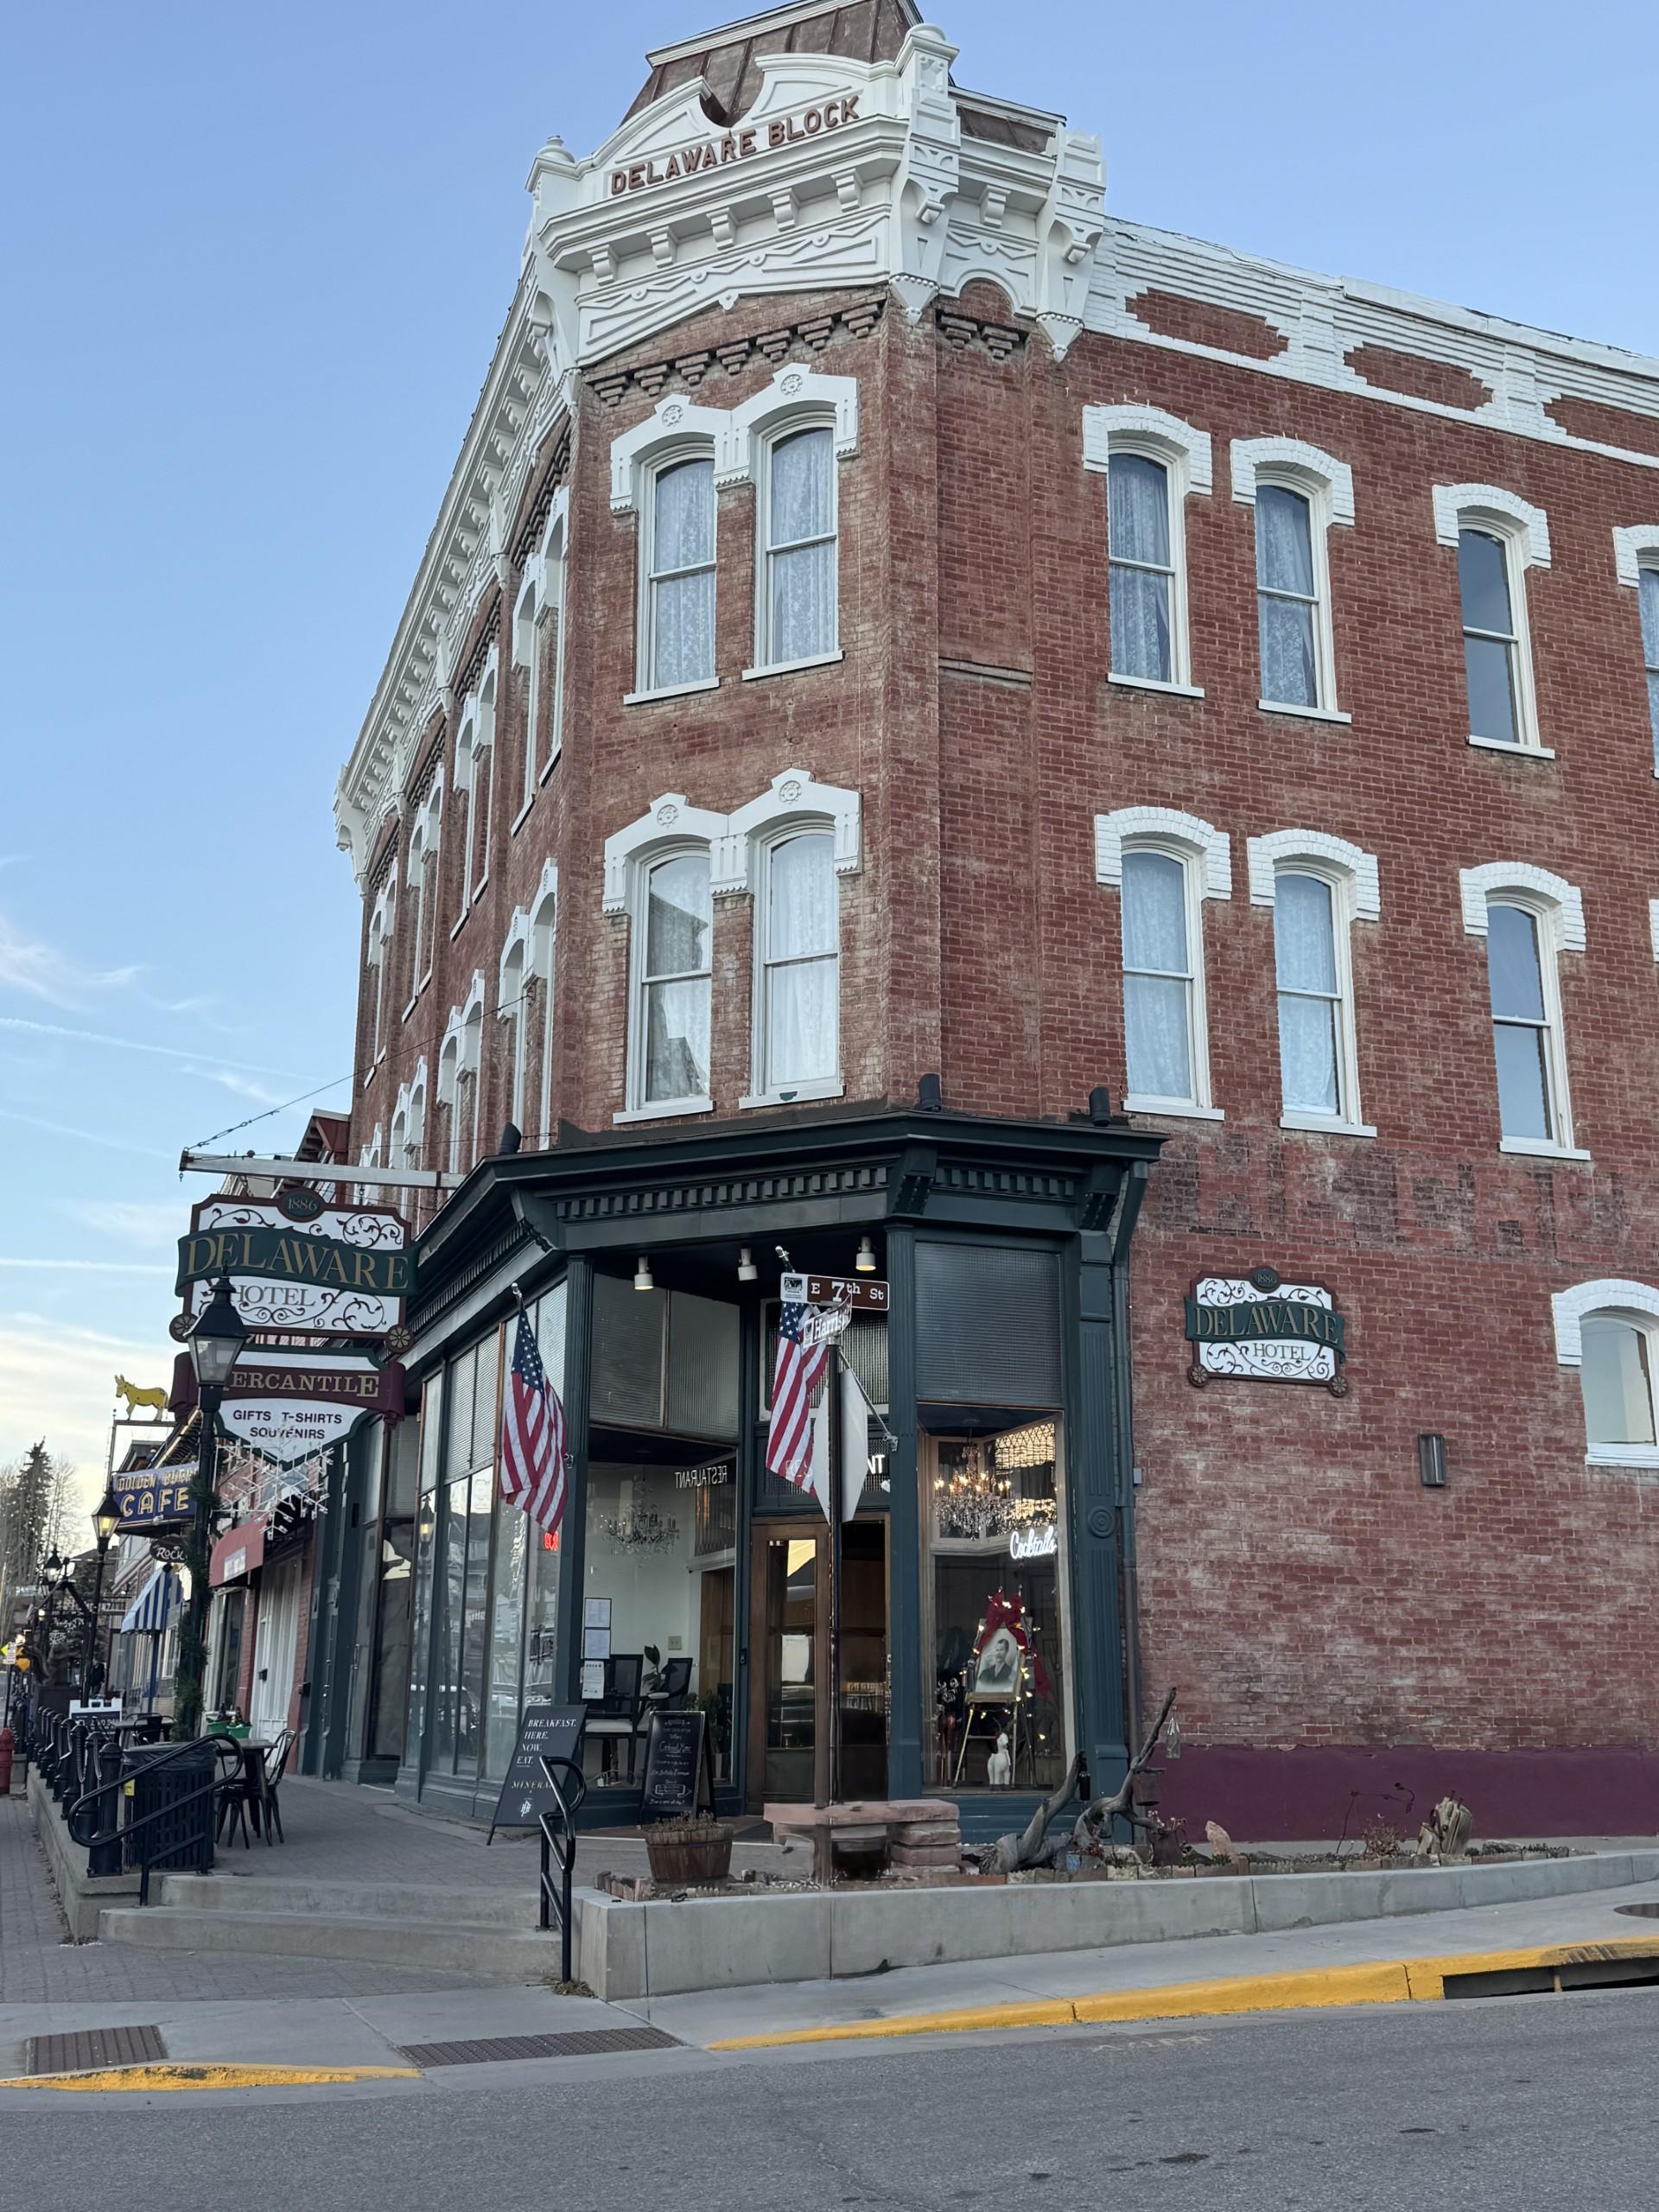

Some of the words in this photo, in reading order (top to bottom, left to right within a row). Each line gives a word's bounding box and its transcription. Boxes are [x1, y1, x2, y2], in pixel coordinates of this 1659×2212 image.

[610, 128, 757, 195] DELAWARE
[768, 95, 860, 148] BLOCK
[288, 1198, 318, 1211] 1886
[184, 1231, 410, 1290] DELAWARE
[810, 1282, 821, 1294] E
[831, 1281, 861, 1302] 7th
[869, 1287, 884, 1300] St
[1195, 1304, 1339, 1344] DELAWARE
[1253, 1343, 1312, 1361] HOTEL
[222, 1370, 379, 1397] ERCANTILE
[232, 1409, 271, 1421] GIFTS
[282, 1412, 343, 1424] T-SHIRTS
[250, 1427, 326, 1440] SOUVENIRS
[122, 1487, 189, 1517] CAFE
[1010, 1525, 1058, 1560] Cocktails
[528, 1719, 576, 1727] BREAKFAST.
[524, 1731, 549, 1739] HERE.
[512, 1781, 552, 1789] MINERA
